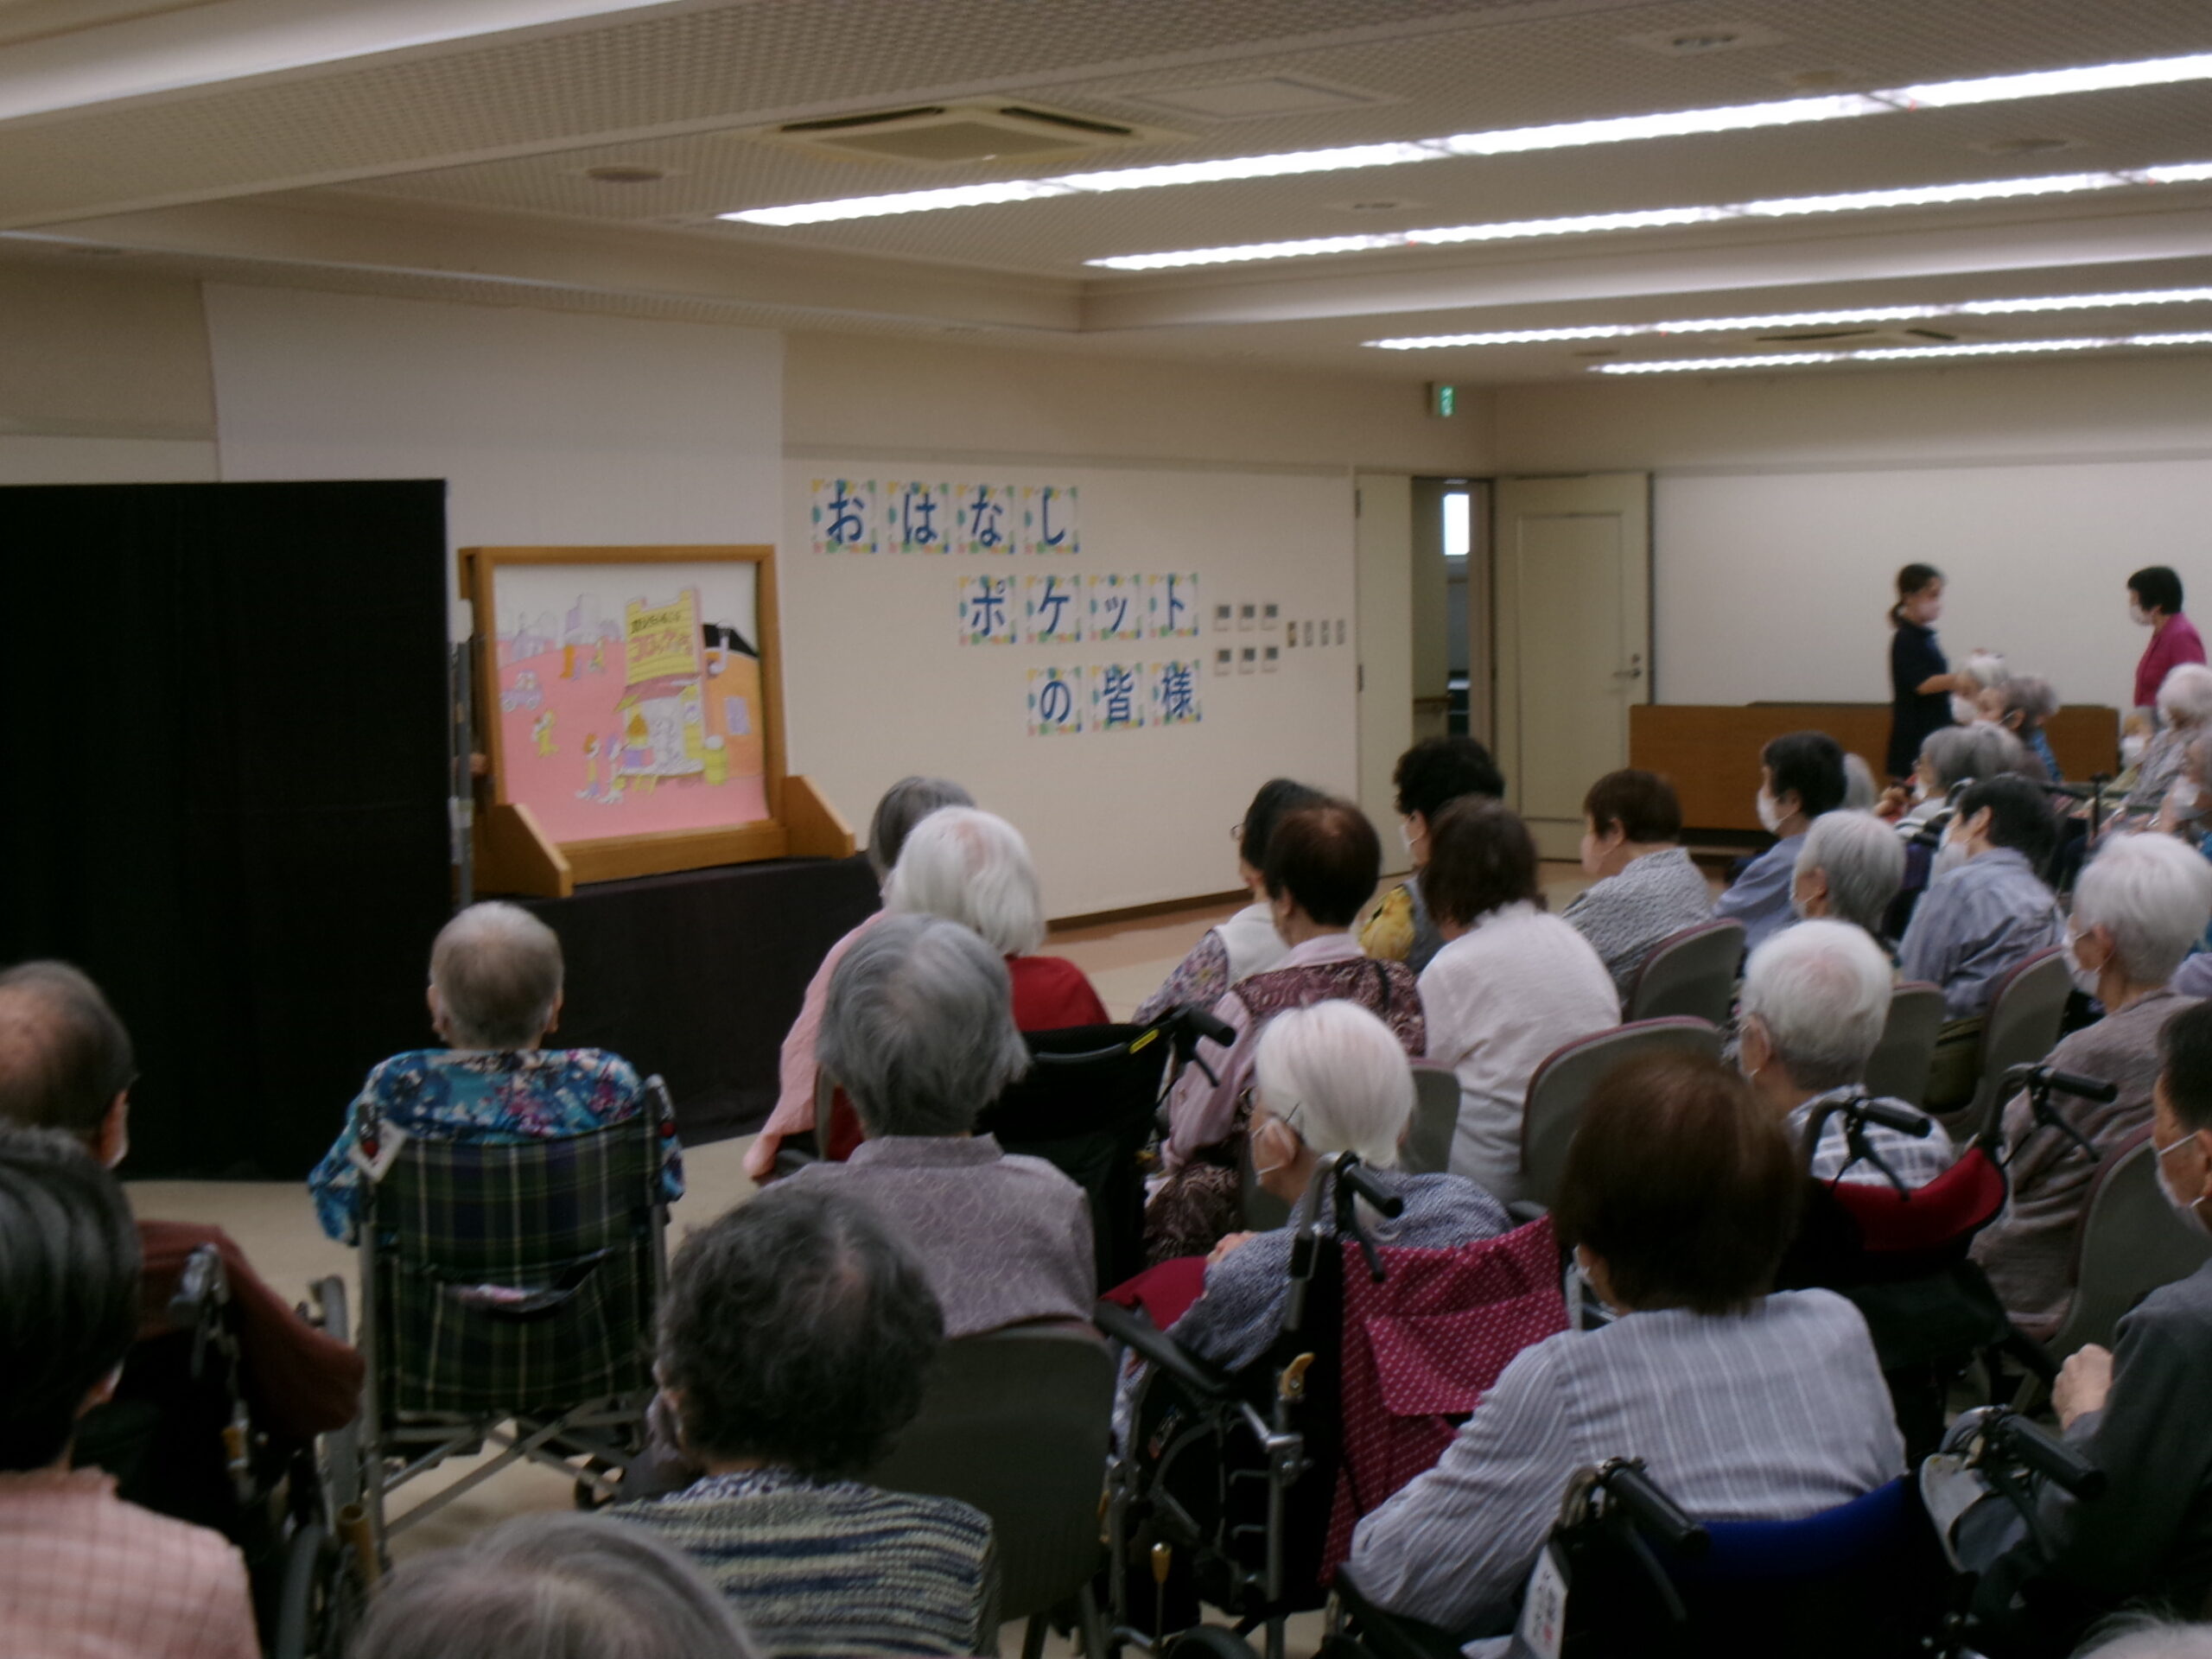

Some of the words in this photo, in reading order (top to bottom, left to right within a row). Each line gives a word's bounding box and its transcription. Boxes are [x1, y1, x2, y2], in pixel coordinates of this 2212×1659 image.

[827, 487, 1066, 546] おはなし
[971, 579, 1185, 636] ポケット
[1040, 664, 1193, 724] の皆様
